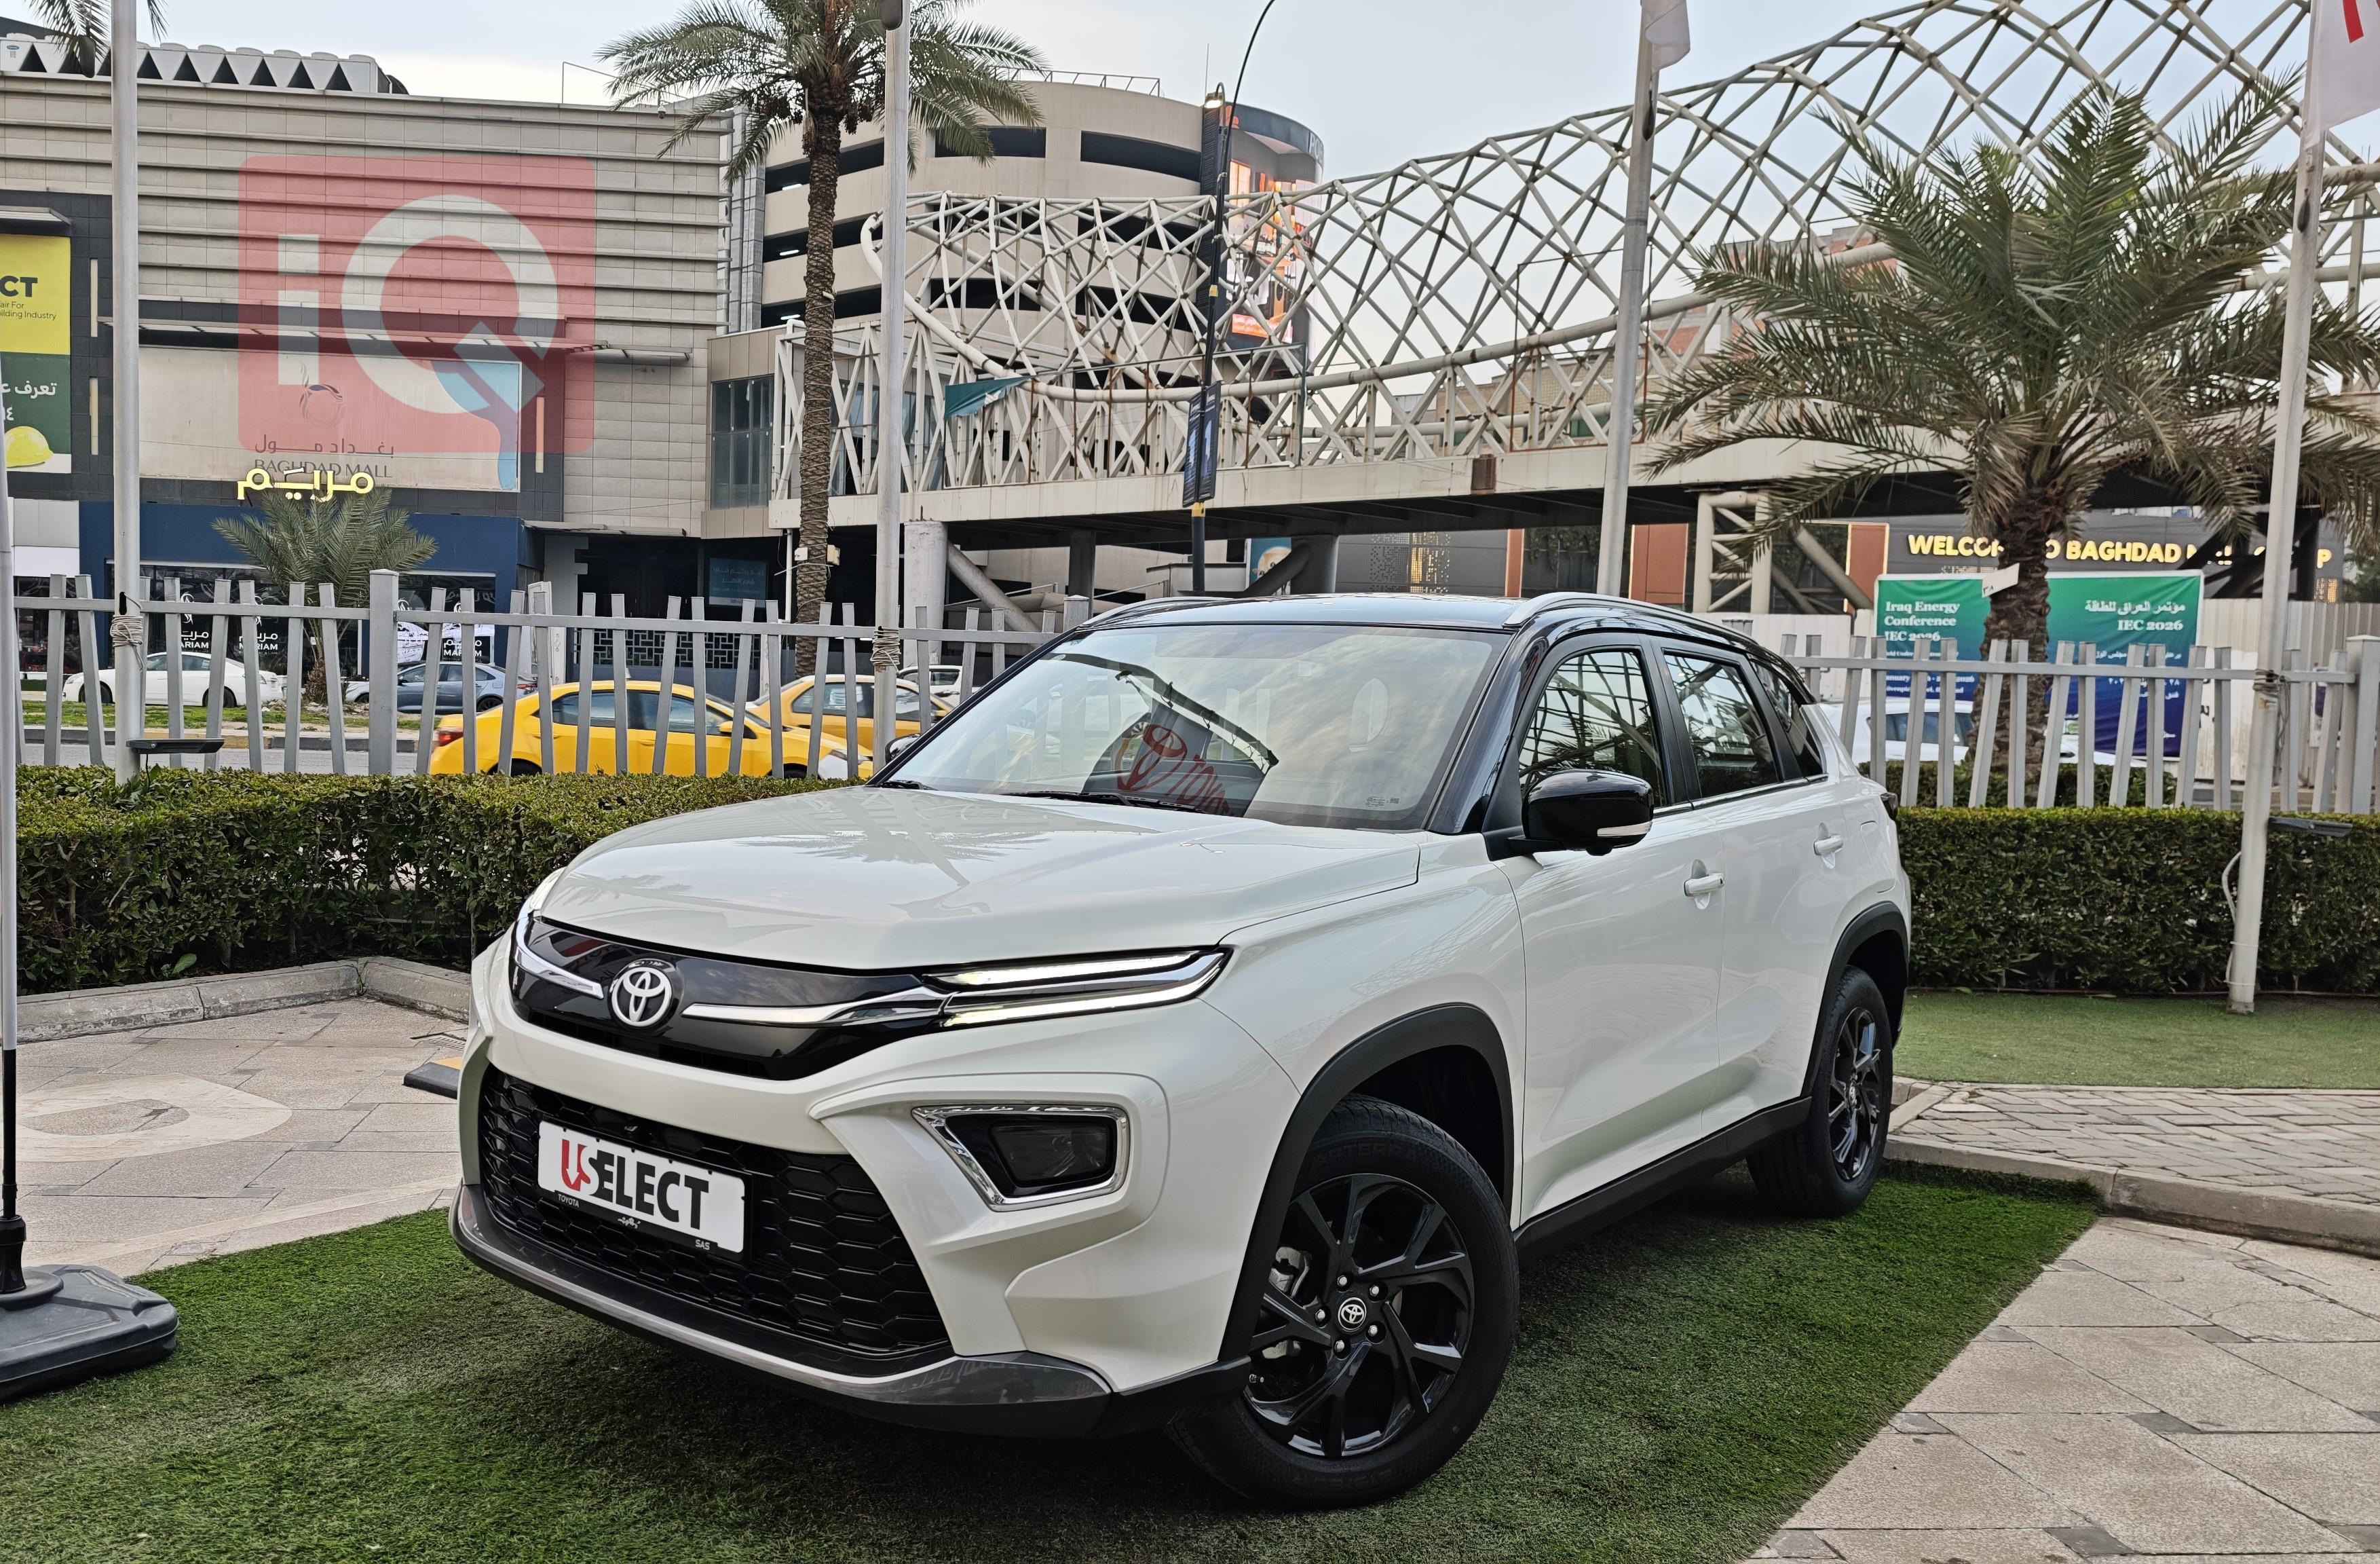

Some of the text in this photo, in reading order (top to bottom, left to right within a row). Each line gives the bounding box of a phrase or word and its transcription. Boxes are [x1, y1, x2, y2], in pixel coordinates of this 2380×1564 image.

[12, 301, 24, 309] For
[24, 311, 56, 320] Industry
[14, 380, 58, 399] تعرف
[2066, 540, 2183, 563] BAGHDAD
[1885, 601, 1960, 614] Iraq Energy
[1884, 614, 1957, 626] Conference
[2117, 619, 2184, 631] IEC 2026
[1885, 631, 1908, 641] IEC
[558, 1193, 580, 1208] TOYOTA
[695, 1239, 711, 1250] SAS
